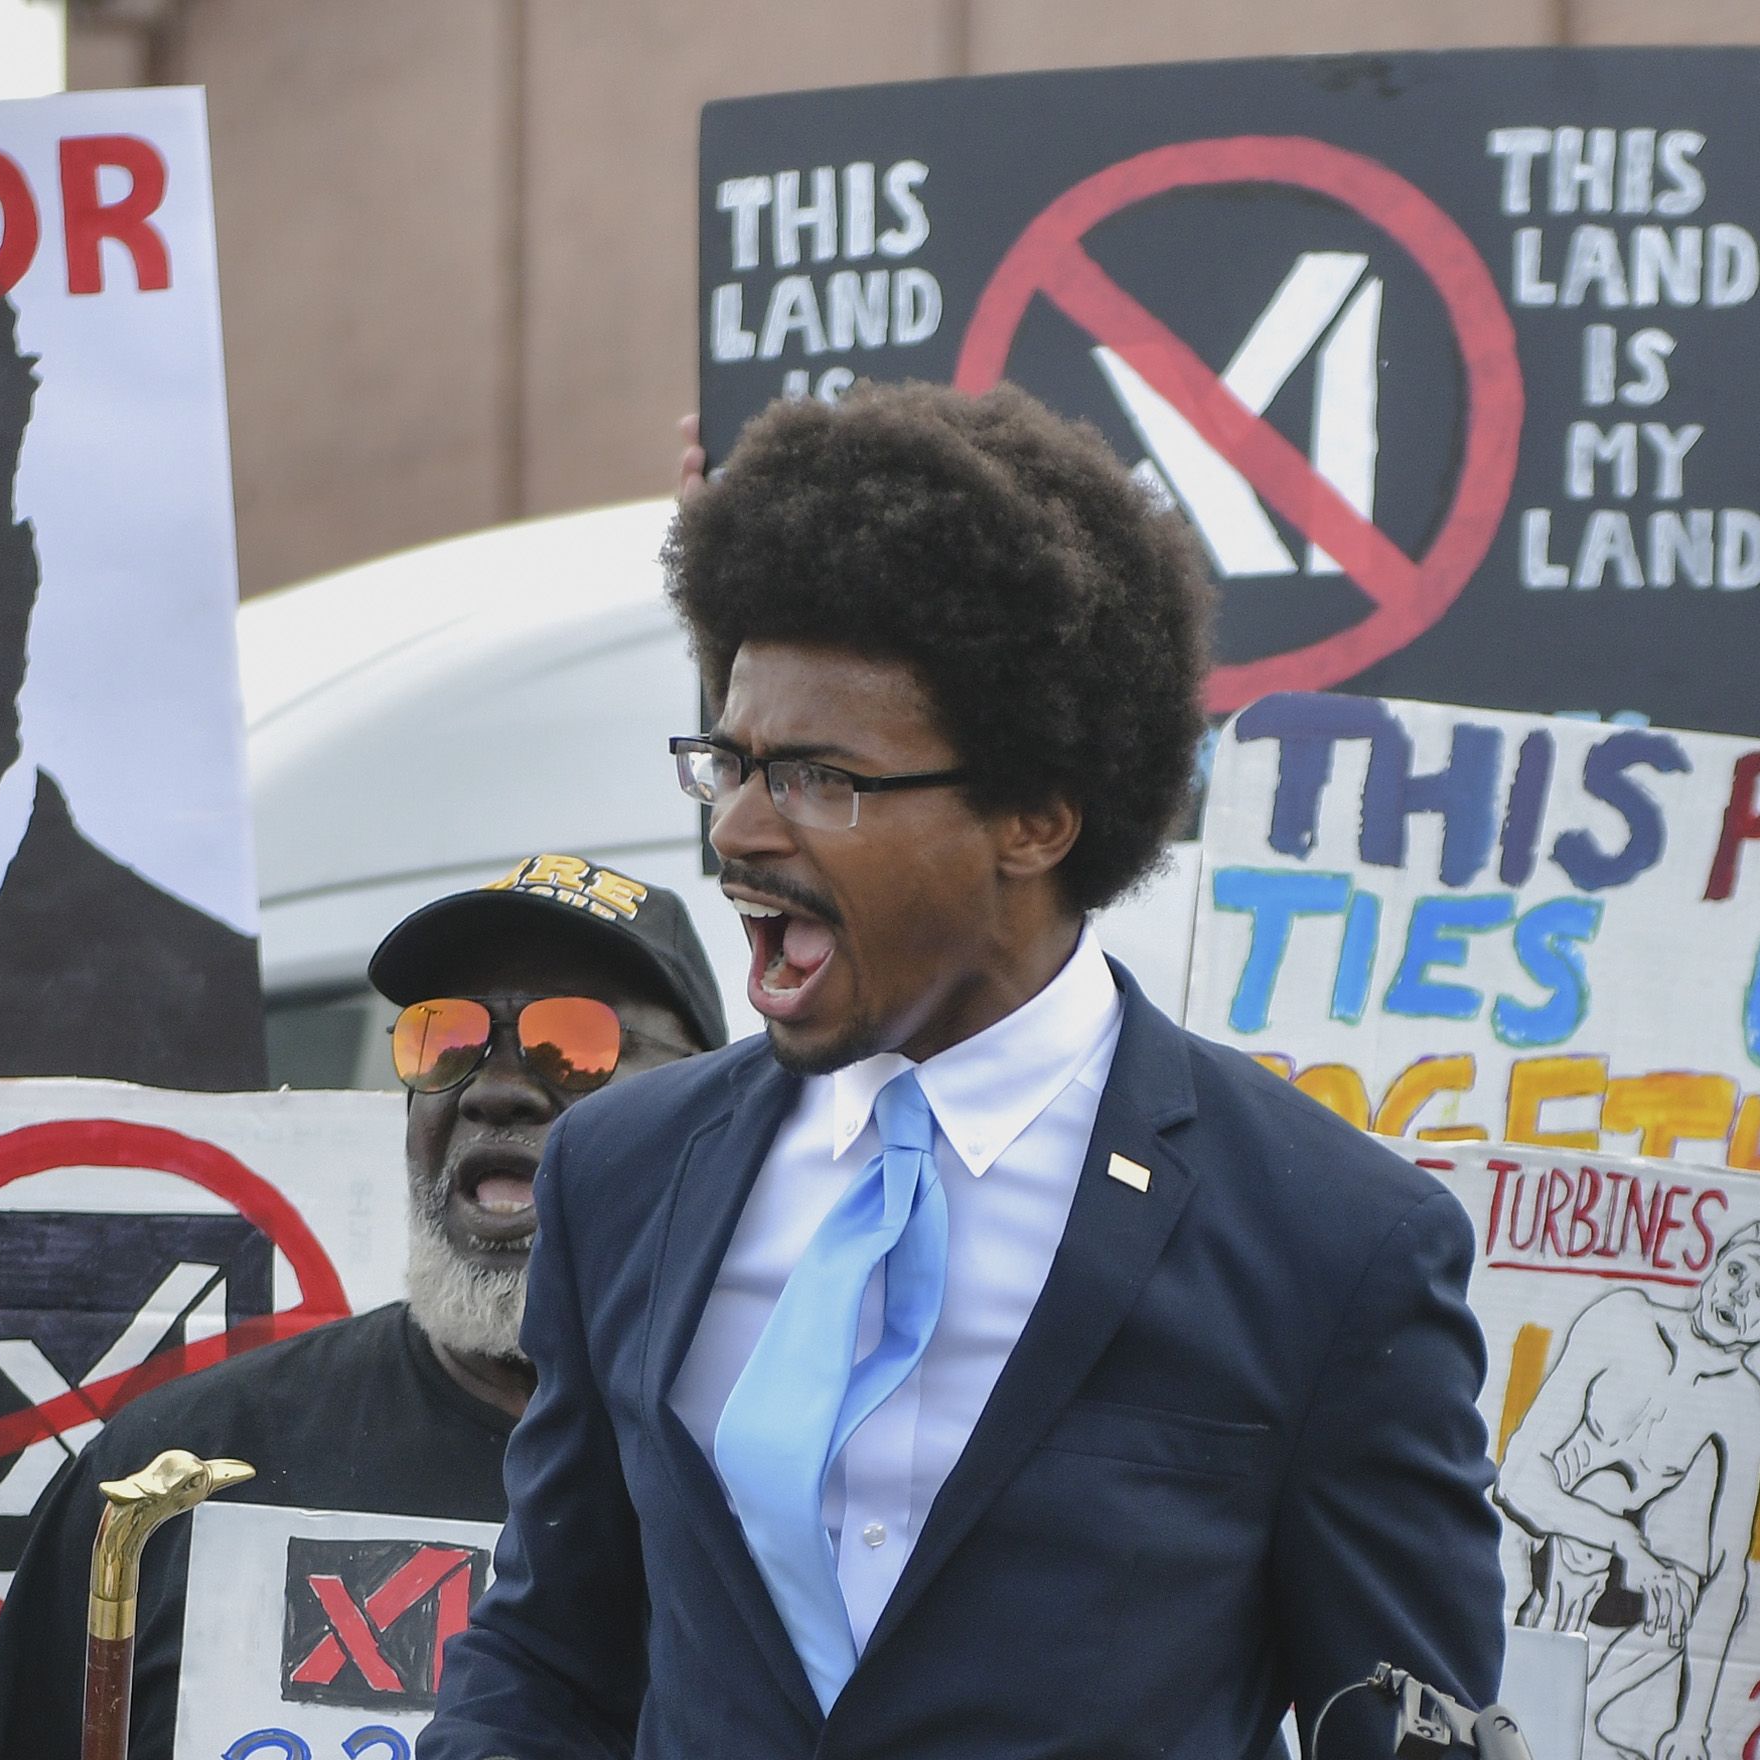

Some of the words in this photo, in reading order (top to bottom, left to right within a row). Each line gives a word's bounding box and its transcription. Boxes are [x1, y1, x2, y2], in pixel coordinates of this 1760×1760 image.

[716, 159, 930, 271] THIS
[1486, 126, 1706, 216] THIS
[1513, 223, 1760, 307] LAND
[710, 267, 942, 362] LAND
[1583, 323, 1677, 407] IS
[1565, 421, 1704, 498] MY
[1235, 692, 1692, 891] THIS
[1211, 867, 1604, 1048] TIES
[1485, 1159, 1728, 1272] TURBINES
